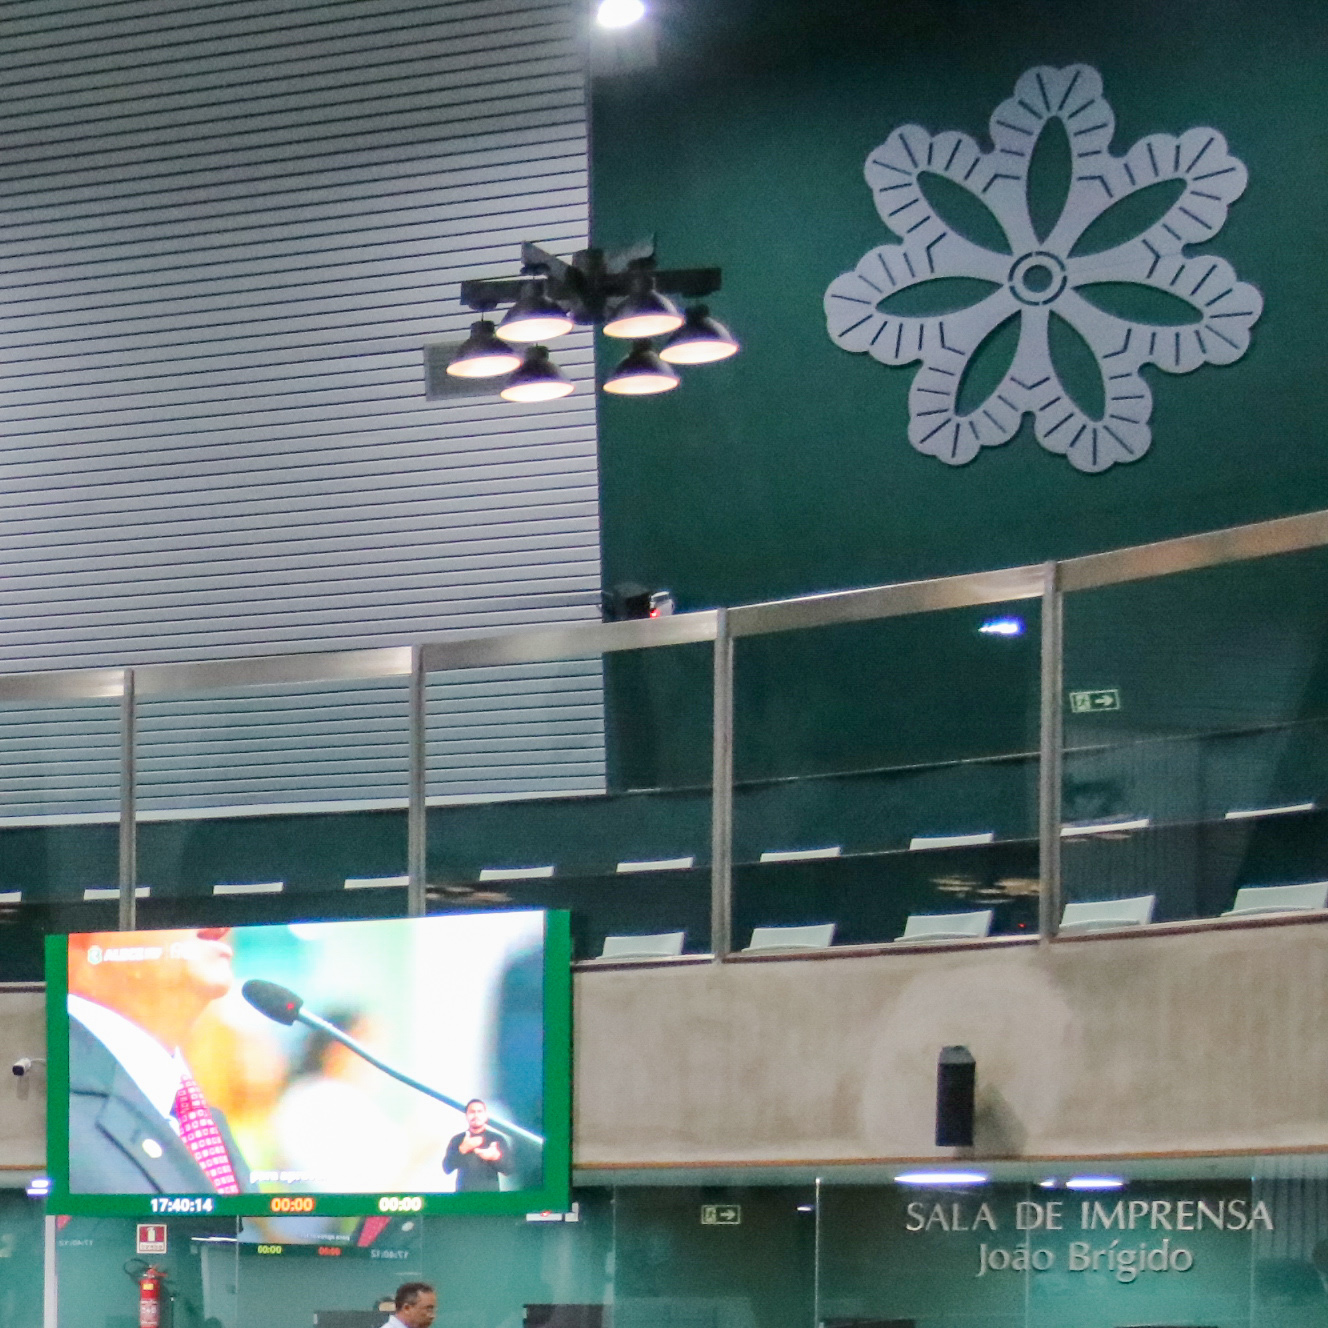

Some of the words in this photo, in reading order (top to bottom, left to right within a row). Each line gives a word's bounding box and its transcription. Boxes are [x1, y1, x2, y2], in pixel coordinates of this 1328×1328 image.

[150, 1198, 213, 1212] 17:40:14
[270, 1197, 314, 1212] 00:00
[378, 1197, 422, 1212] 00:00
[906, 1201, 997, 1231] SALA
[1016, 1201, 1063, 1231] DE
[1080, 1200, 1274, 1231] IMPRENSA
[975, 1243, 1055, 1278] João
[1069, 1239, 1194, 1284] Brígido
